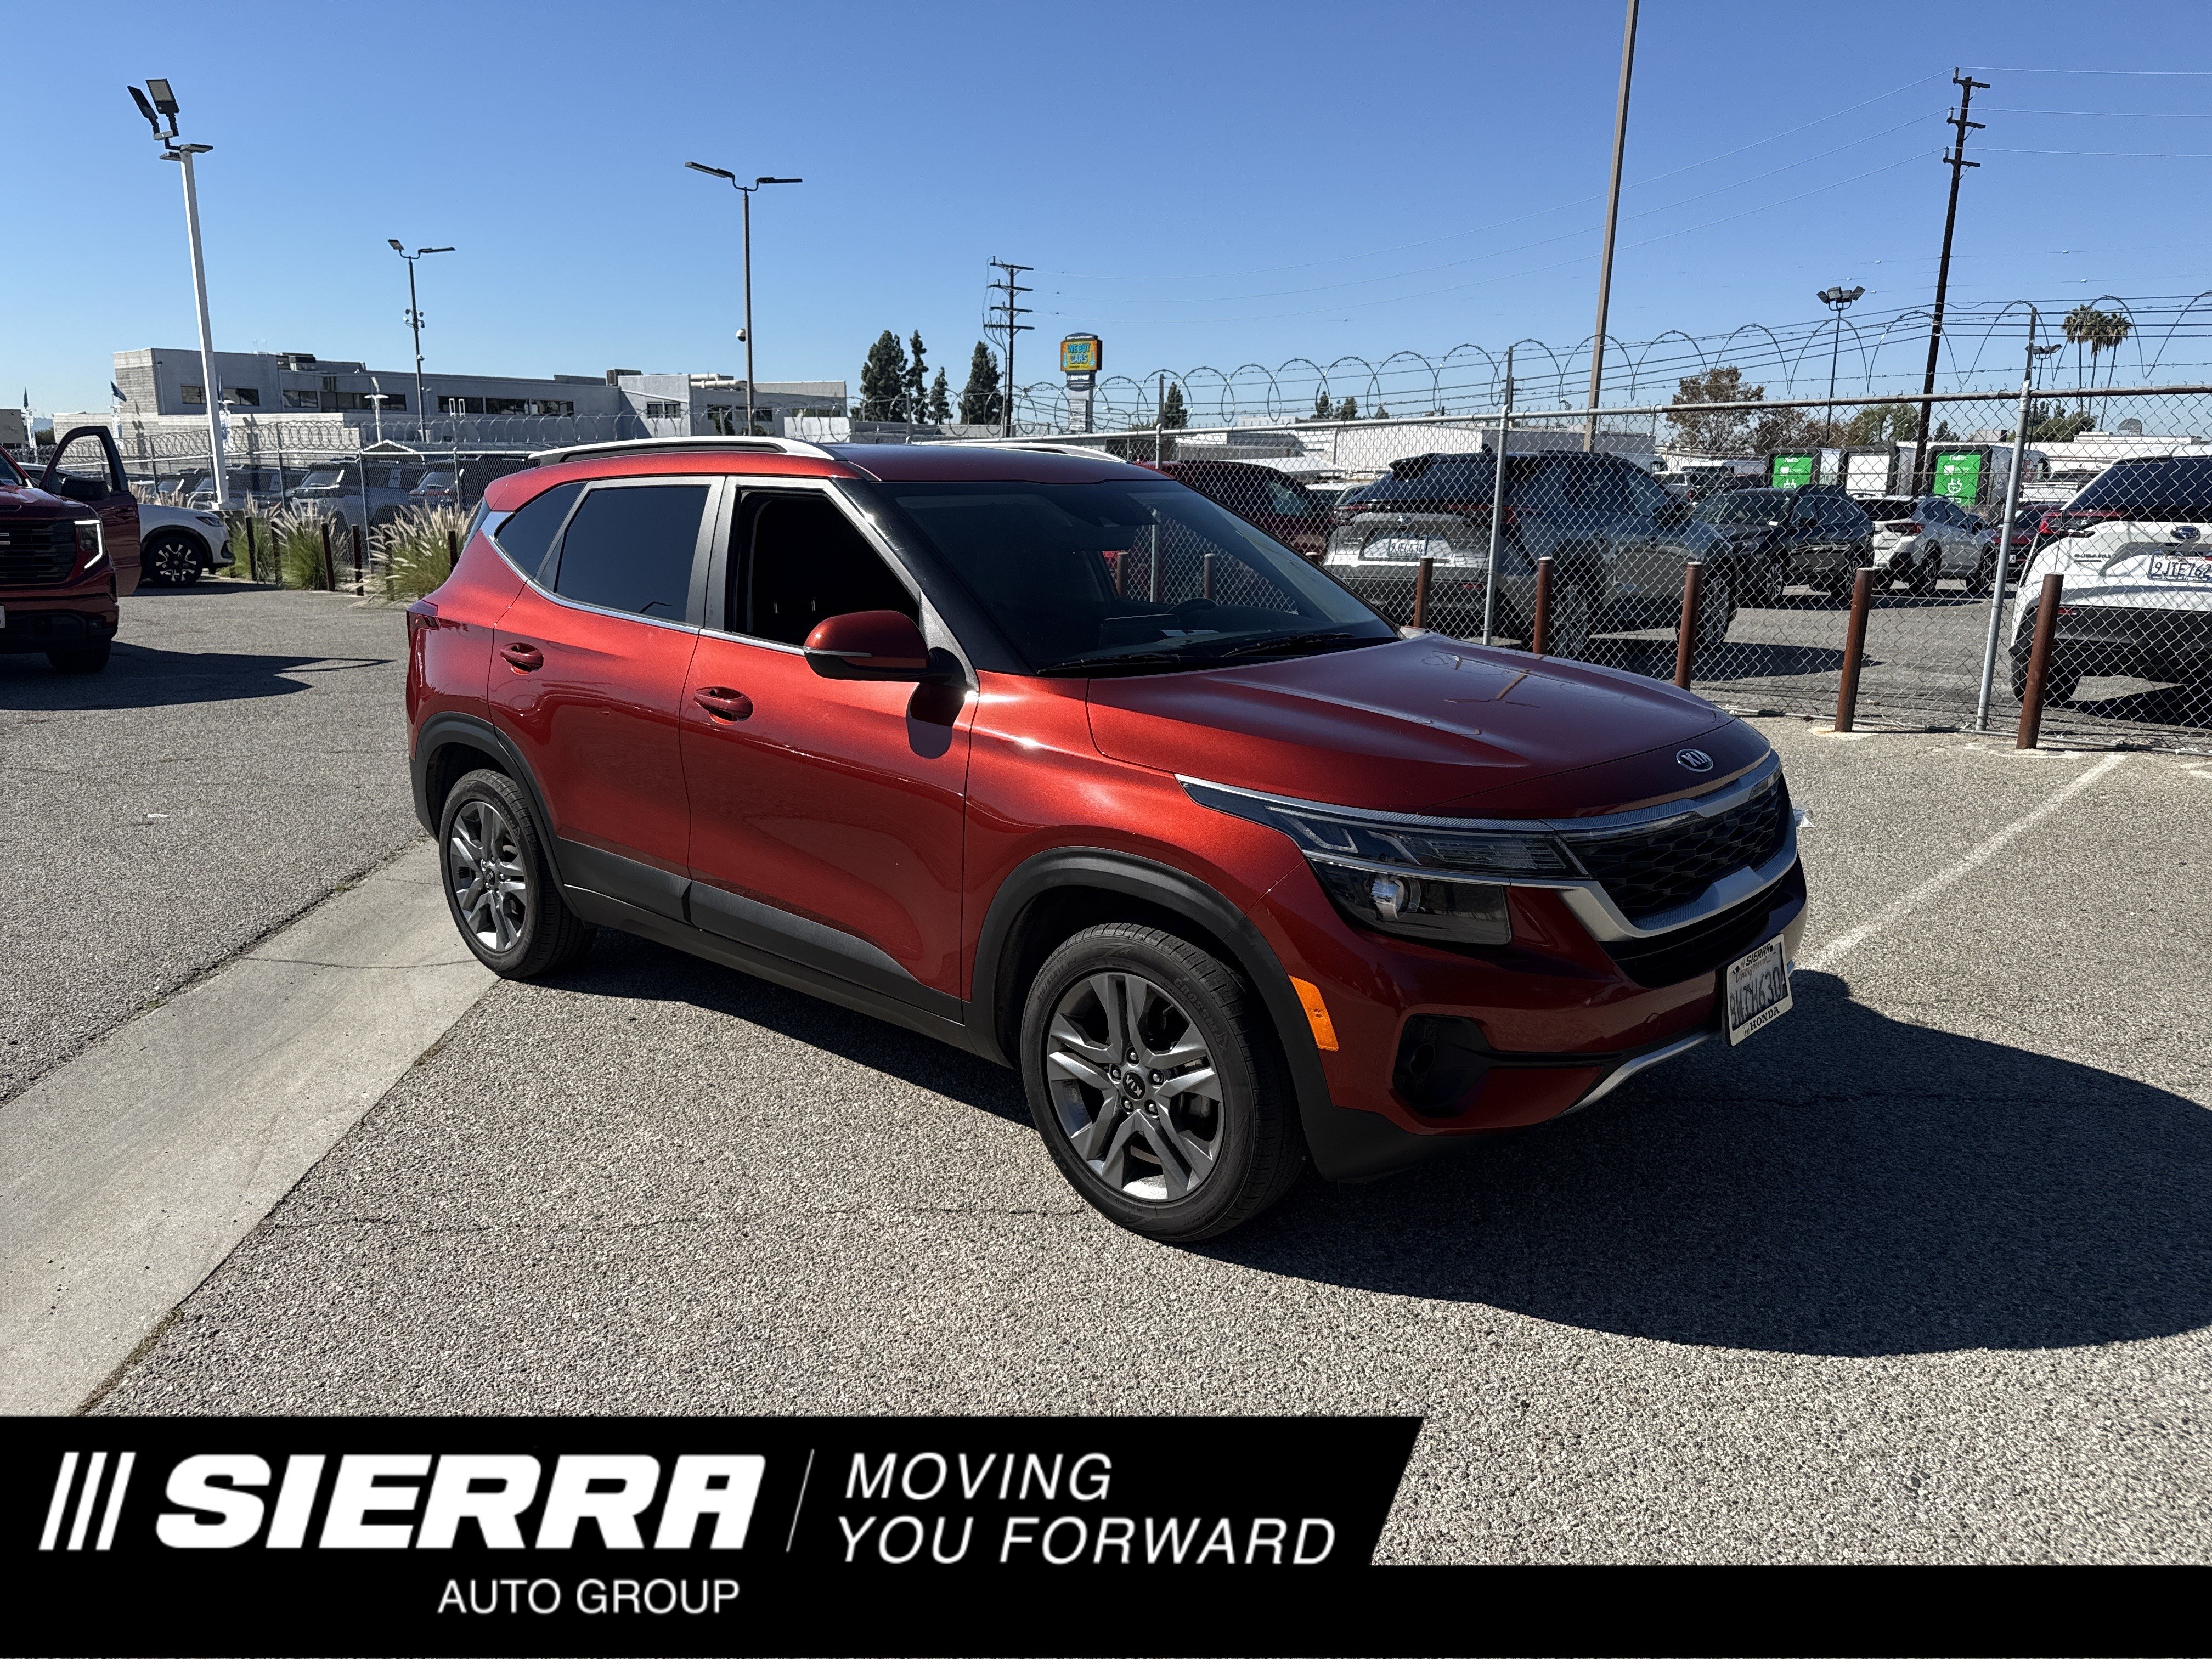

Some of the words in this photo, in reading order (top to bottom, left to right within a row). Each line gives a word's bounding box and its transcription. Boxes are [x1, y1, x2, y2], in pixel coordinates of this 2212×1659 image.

[1070, 354, 1088, 364] CARS
[2151, 562, 2211, 578] 9JTE762
[1681, 751, 1711, 768] KIA
[1746, 943, 1770, 967] SIERRA
[1173, 977, 1230, 1053] CROSSMAX
[1750, 1006, 1780, 1031] HONDA
[1126, 1074, 1143, 1097] KIA
